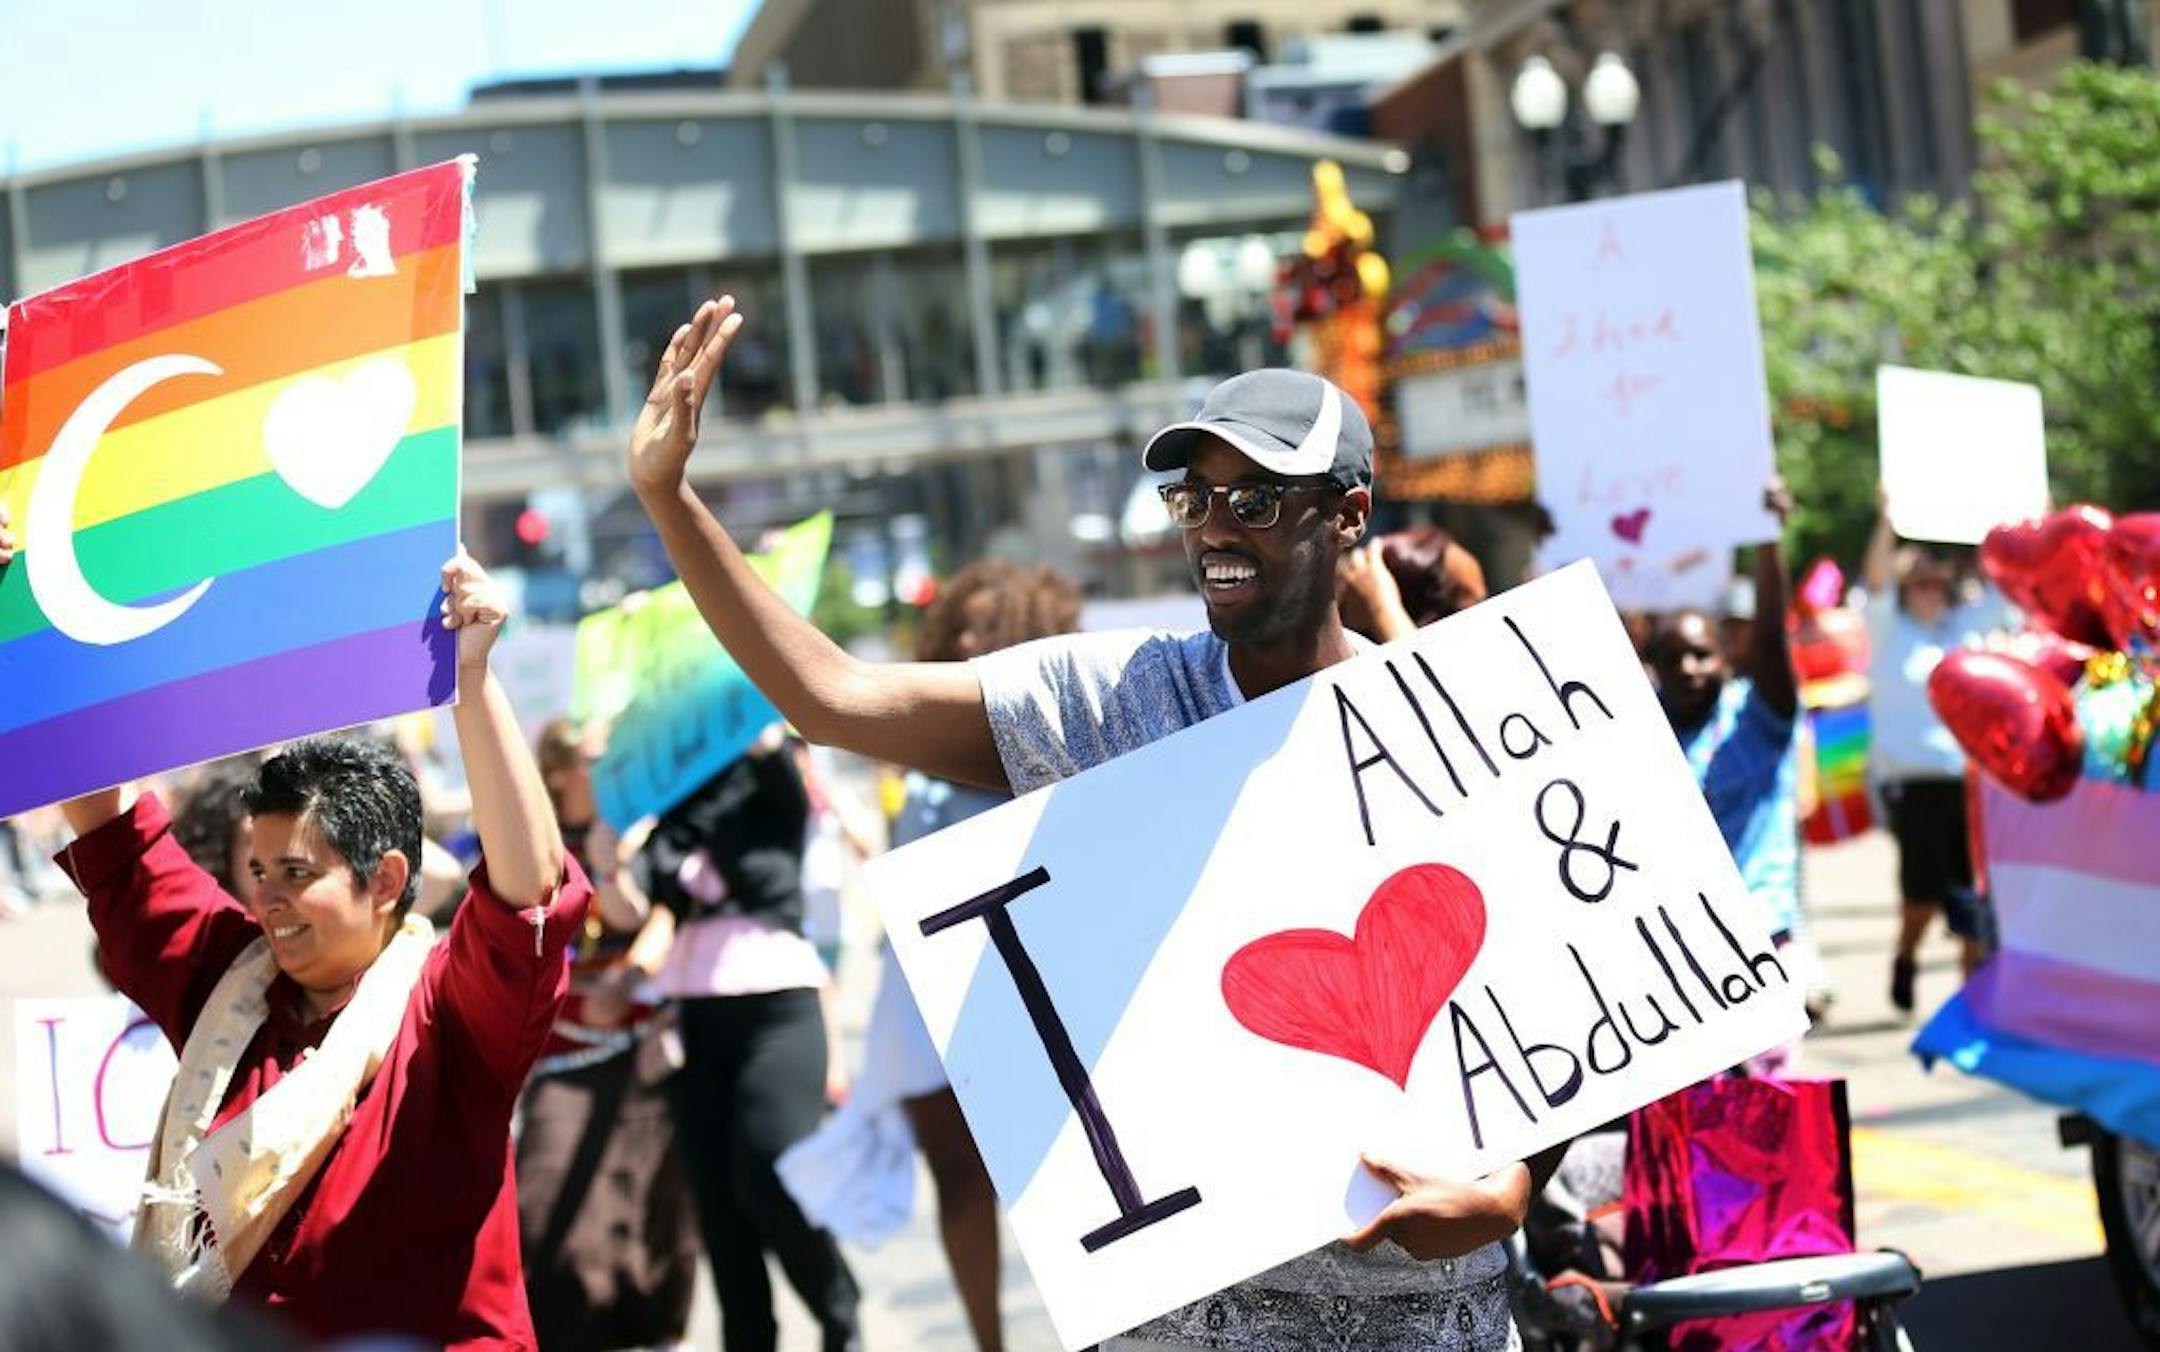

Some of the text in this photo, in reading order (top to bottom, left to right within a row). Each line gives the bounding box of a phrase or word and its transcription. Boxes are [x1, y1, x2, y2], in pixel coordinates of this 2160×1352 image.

[1333, 616, 1614, 846] Allah
[1535, 778, 1639, 903] &
[918, 865, 1203, 1254] I
[1449, 892, 1789, 1149] Abdullah
